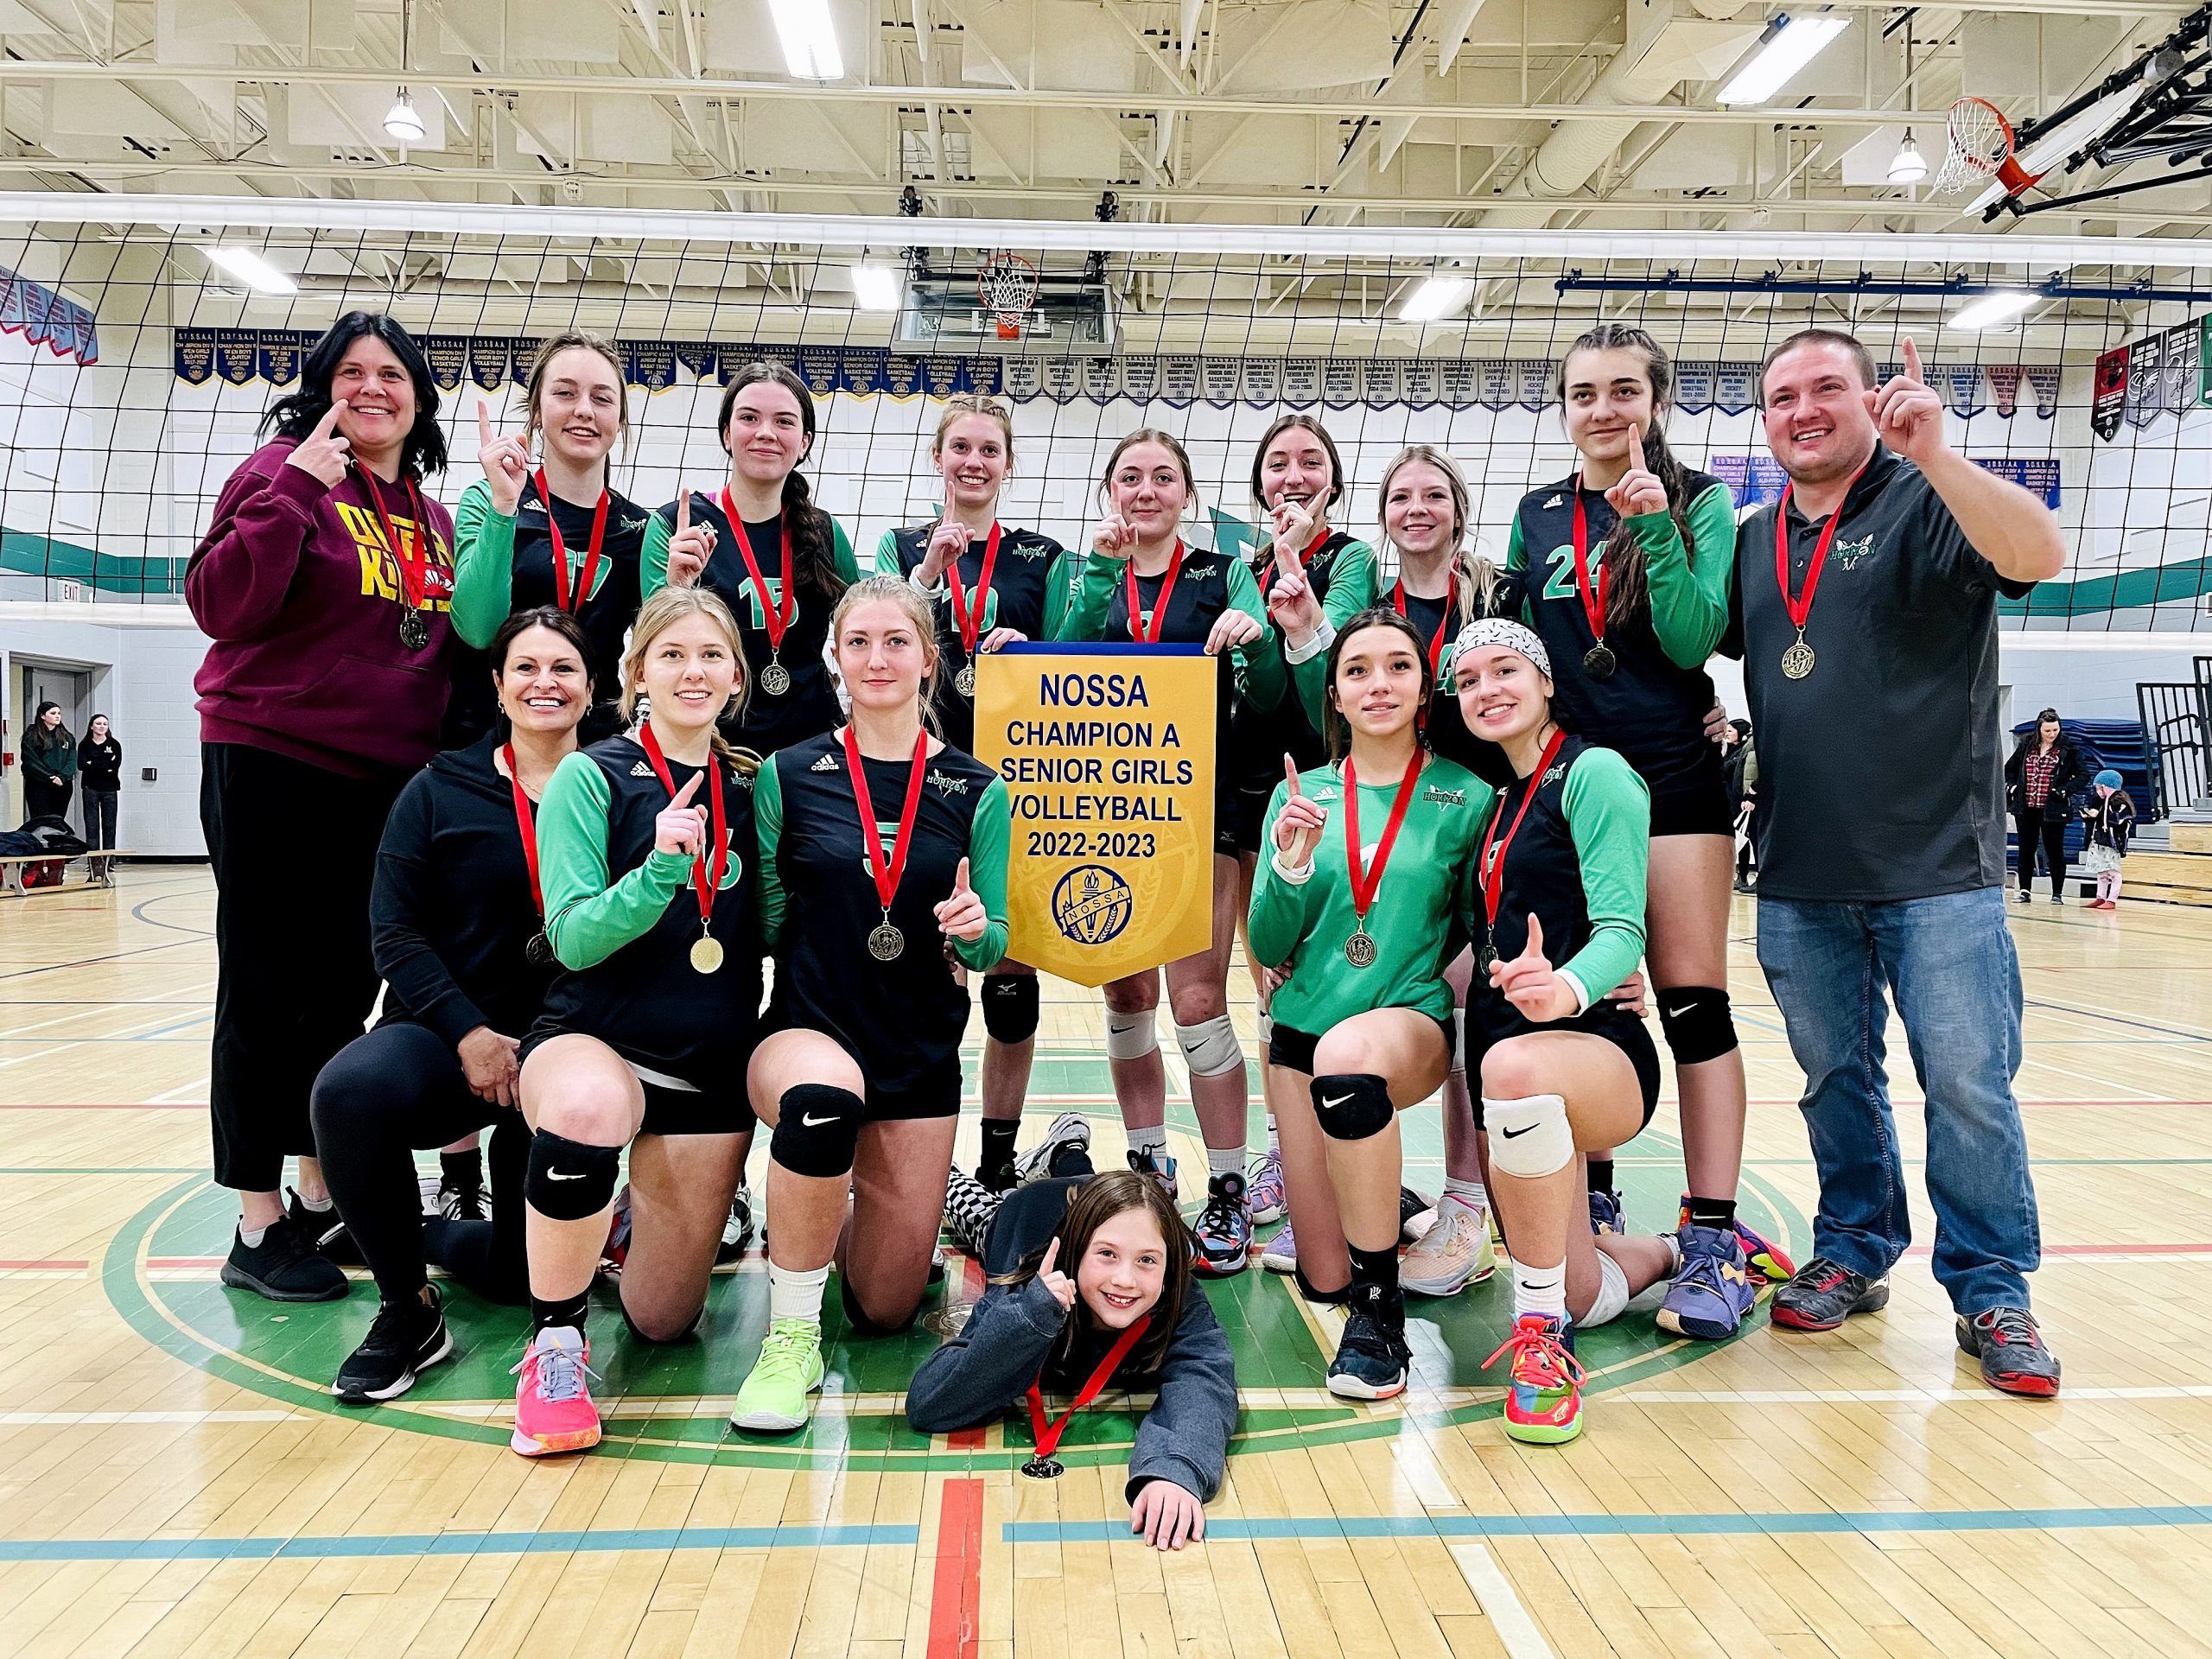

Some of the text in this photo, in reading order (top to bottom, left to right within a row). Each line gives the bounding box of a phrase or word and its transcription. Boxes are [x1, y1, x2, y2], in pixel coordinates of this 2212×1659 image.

[1013, 549, 1047, 558] HORIZON
[1828, 545, 1876, 561] HORIZON
[1542, 540, 1610, 601] 24
[65, 584, 78, 601] EXIT
[739, 576, 799, 631] 15
[941, 583, 999, 634] 10
[1039, 674, 1149, 708] NOSSA
[1007, 721, 1181, 748] CHAMPION A
[810, 763, 840, 772] adidas
[1001, 757, 1193, 785] SENIOR GIRLS
[926, 775, 969, 795] HORIZON
[1422, 791, 1467, 807] HORIZON
[1010, 794, 1183, 822] VOLLEYBALL
[862, 821, 907, 880] 5
[1027, 831, 1156, 858] 2022-2023
[686, 828, 743, 891] 16
[1358, 842, 1381, 903] 1
[1068, 889, 1125, 922] NOSSA
